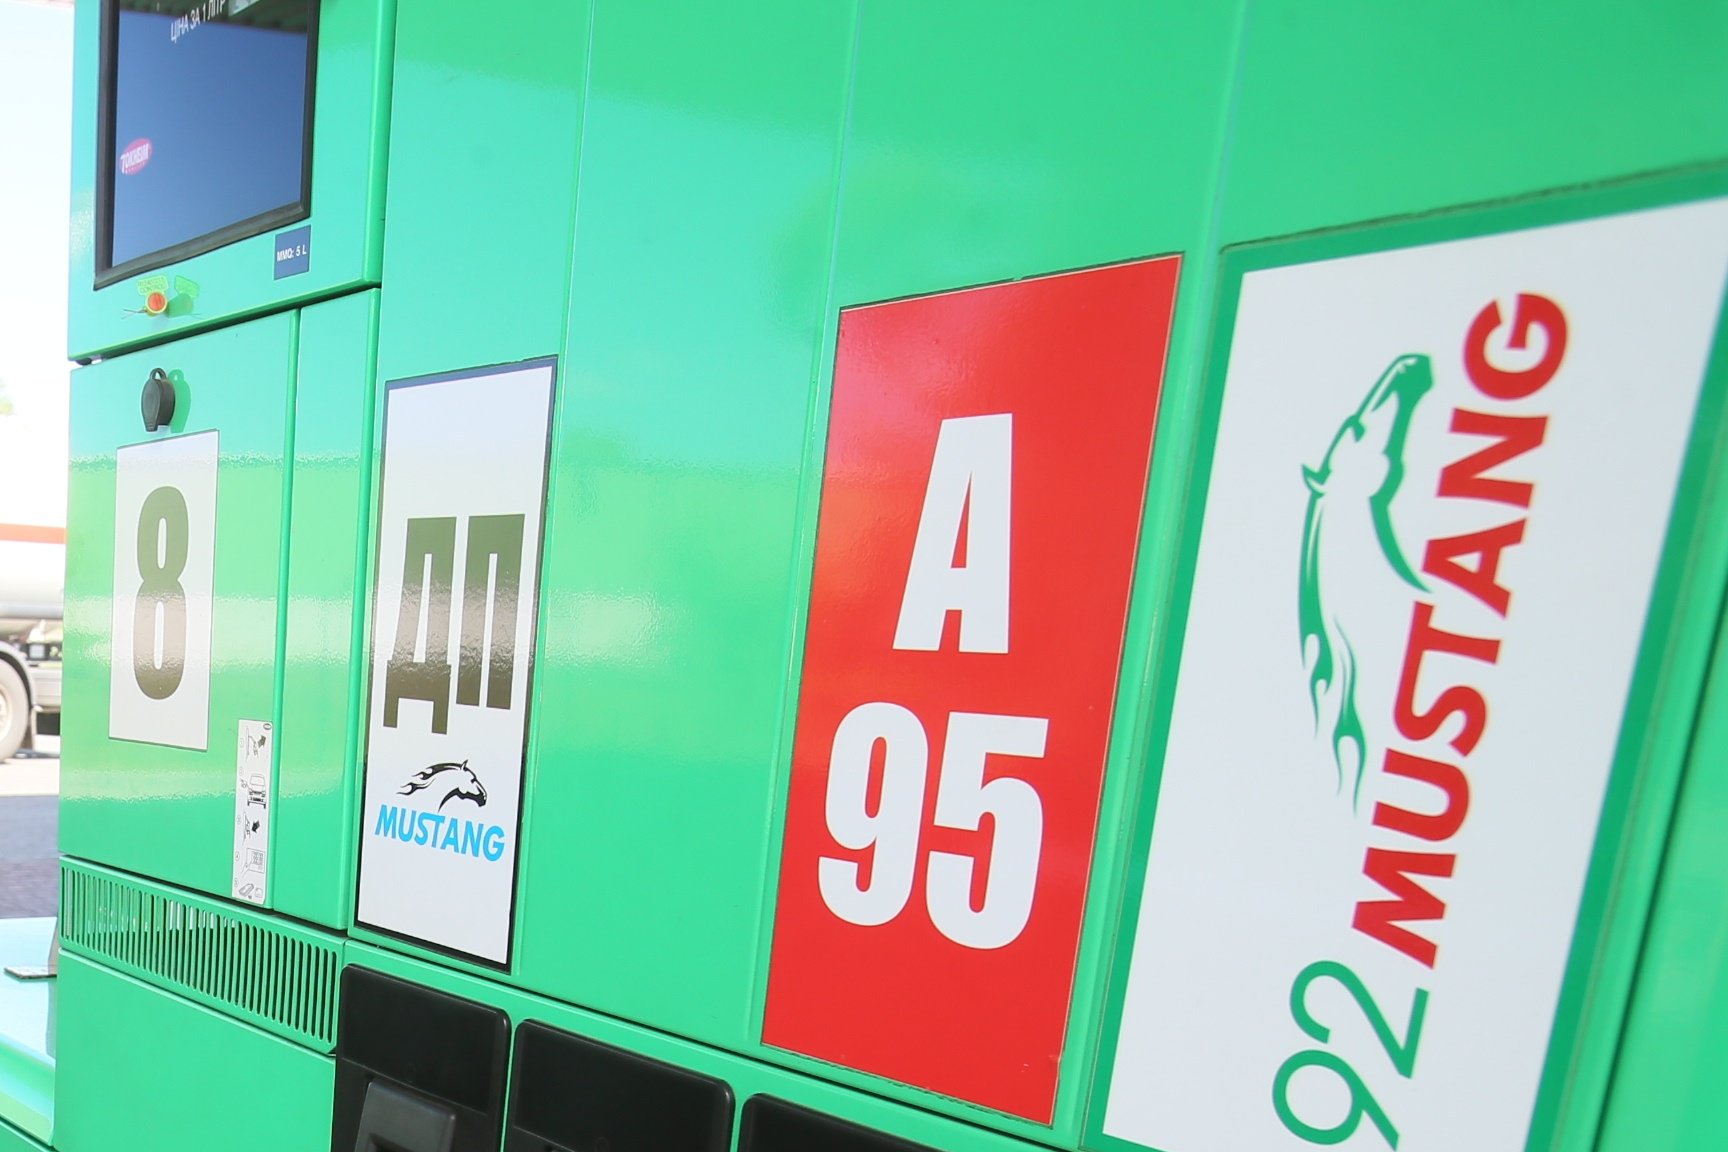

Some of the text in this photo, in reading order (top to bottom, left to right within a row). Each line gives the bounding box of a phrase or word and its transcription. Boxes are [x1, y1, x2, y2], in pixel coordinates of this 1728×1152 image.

[170, 14, 189, 44] ЦІНА
[190, 7, 200, 30] ЗА
[295, 244, 301, 257] 5
[302, 244, 307, 256] L
[132, 485, 189, 701] 8
[382, 513, 526, 735] ДП
[817, 701, 1050, 950] 95
[1272, 291, 1569, 1152] 92 MUSTANG
[374, 803, 505, 862] MUSTANG
